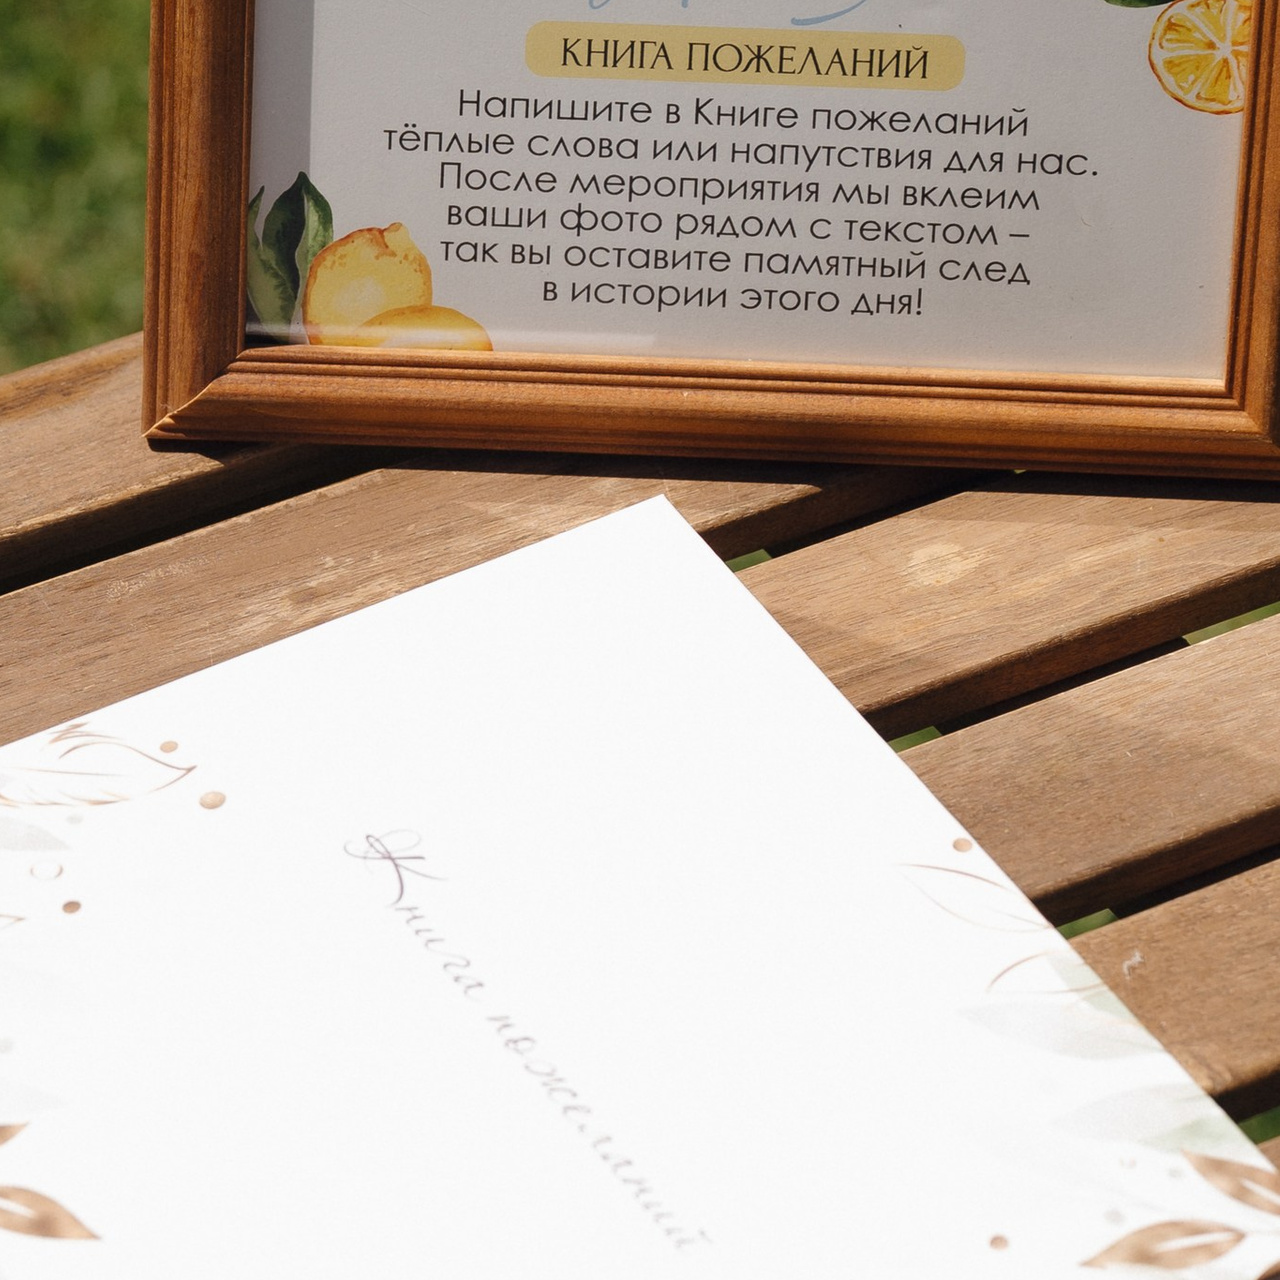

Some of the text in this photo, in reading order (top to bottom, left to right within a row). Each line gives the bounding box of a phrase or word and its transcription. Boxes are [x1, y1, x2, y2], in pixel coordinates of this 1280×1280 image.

[560, 36, 930, 80] КНИГА ПОЖЕЛАНИЙ
[458, 87, 1029, 138] Напишите в Книге пожеланий
[382, 121, 1099, 178] тёплые слова или напутствия для нас.
[438, 160, 1041, 212] После мероприятия мы вклеим
[446, 203, 548, 230] ваши
[559, 201, 664, 238] фото
[674, 212, 798, 242] рядом
[808, 217, 833, 241] с
[842, 218, 1000, 247] текстом
[439, 240, 1032, 287] так вы оставите памятный след
[542, 280, 924, 317] в истории этого дня!
[343, 827, 486, 1002] Книга
